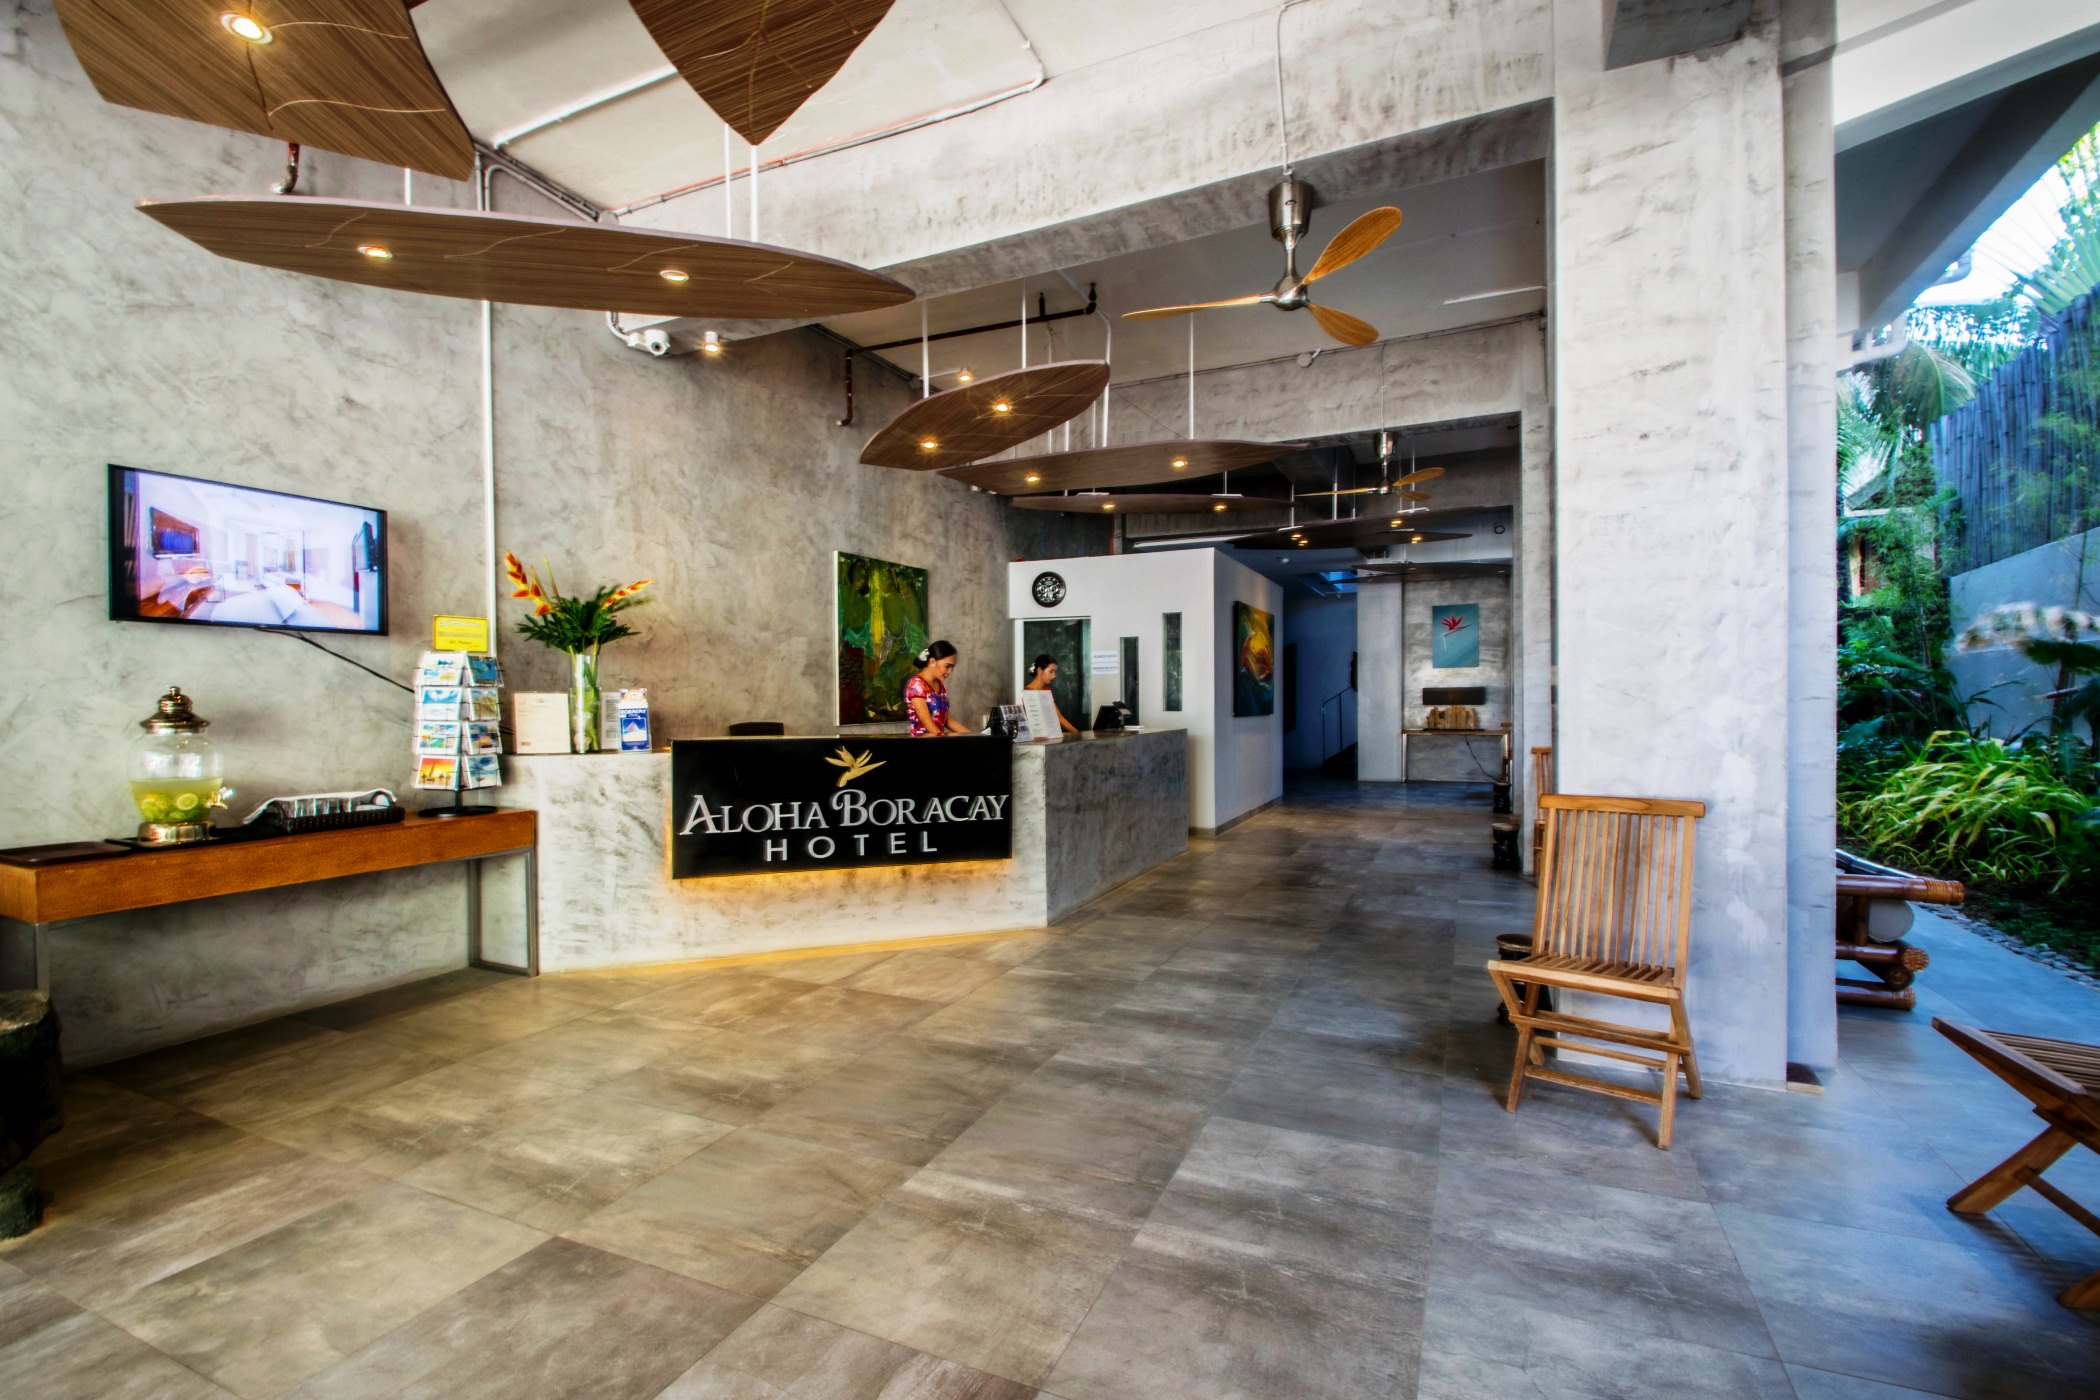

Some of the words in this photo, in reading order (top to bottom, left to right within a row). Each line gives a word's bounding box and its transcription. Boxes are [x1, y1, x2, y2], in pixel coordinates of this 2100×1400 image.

[678, 794, 829, 835] ALOHA
[832, 789, 1009, 827] BORACAY
[764, 831, 938, 862] HOTEL
